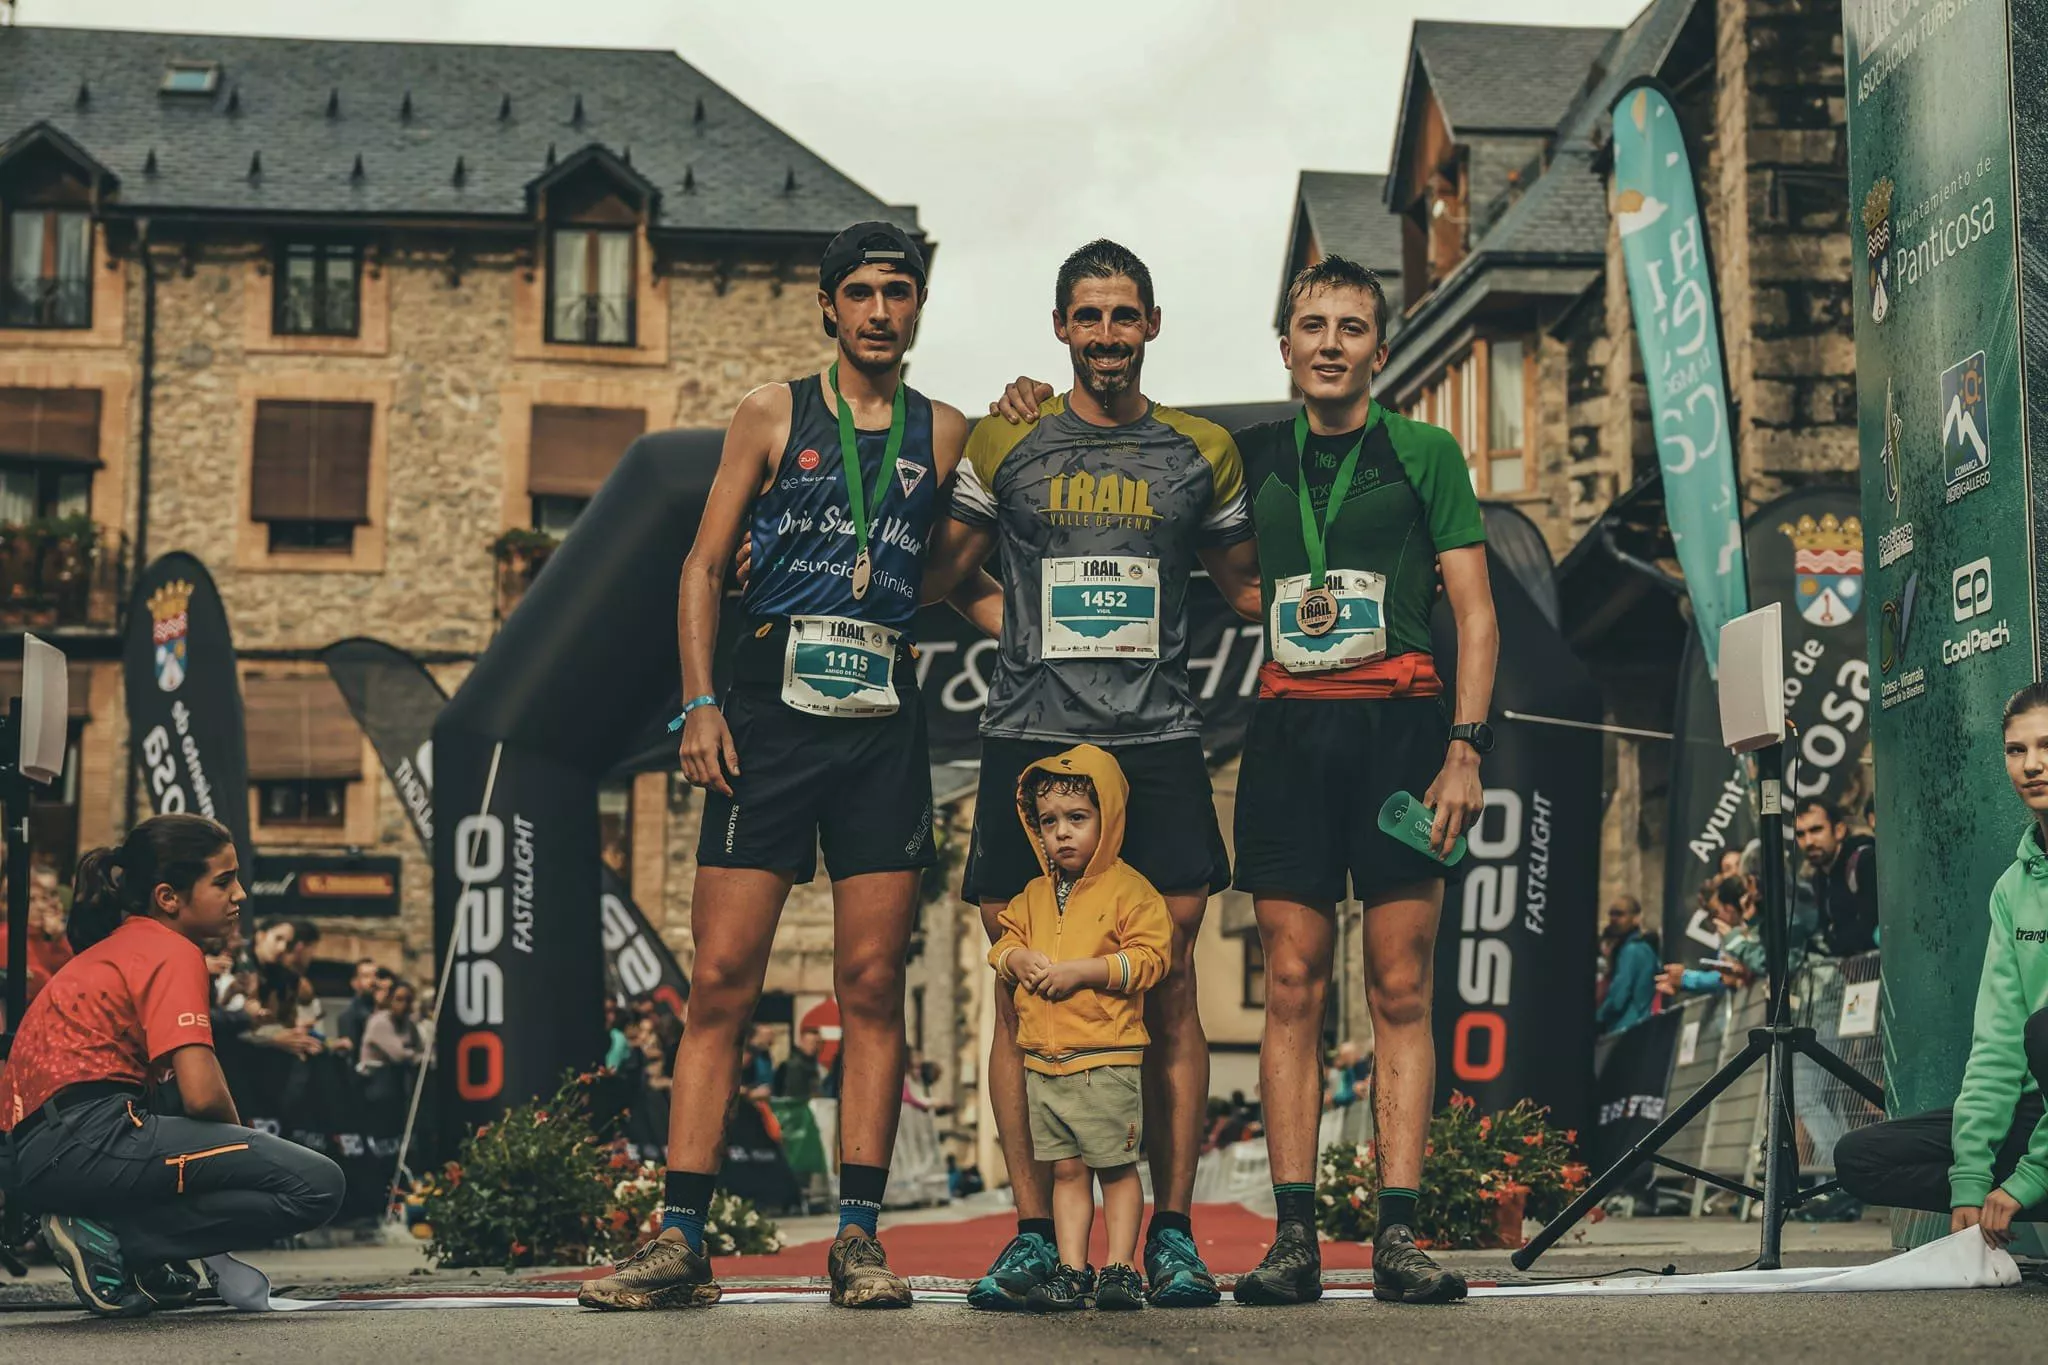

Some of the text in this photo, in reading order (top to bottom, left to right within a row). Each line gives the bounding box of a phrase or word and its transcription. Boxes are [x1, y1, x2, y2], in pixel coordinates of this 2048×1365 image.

[1857, 22, 1918, 106] ASOCIACION
[1895, 157, 1992, 239] Ayuntamiento de
[1896, 196, 1995, 293] Panticosa
[1044, 470, 1154, 514] TRAIL
[1050, 513, 1151, 530] VALLE DE TENA
[1081, 559, 1121, 577] TRAIL
[1325, 574, 1345, 590] AIL
[1081, 591, 1128, 608] 1452
[1299, 602, 1332, 620] TRAIL
[828, 620, 868, 642] TRAIL
[1942, 618, 2010, 665] CoolPack
[826, 650, 868, 672] 1115
[1795, 638, 1826, 676] de
[1525, 789, 1553, 935] FAST&LIGHT
[512, 813, 536, 953] FAST&LIGHT
[178, 1012, 209, 1028] OS
